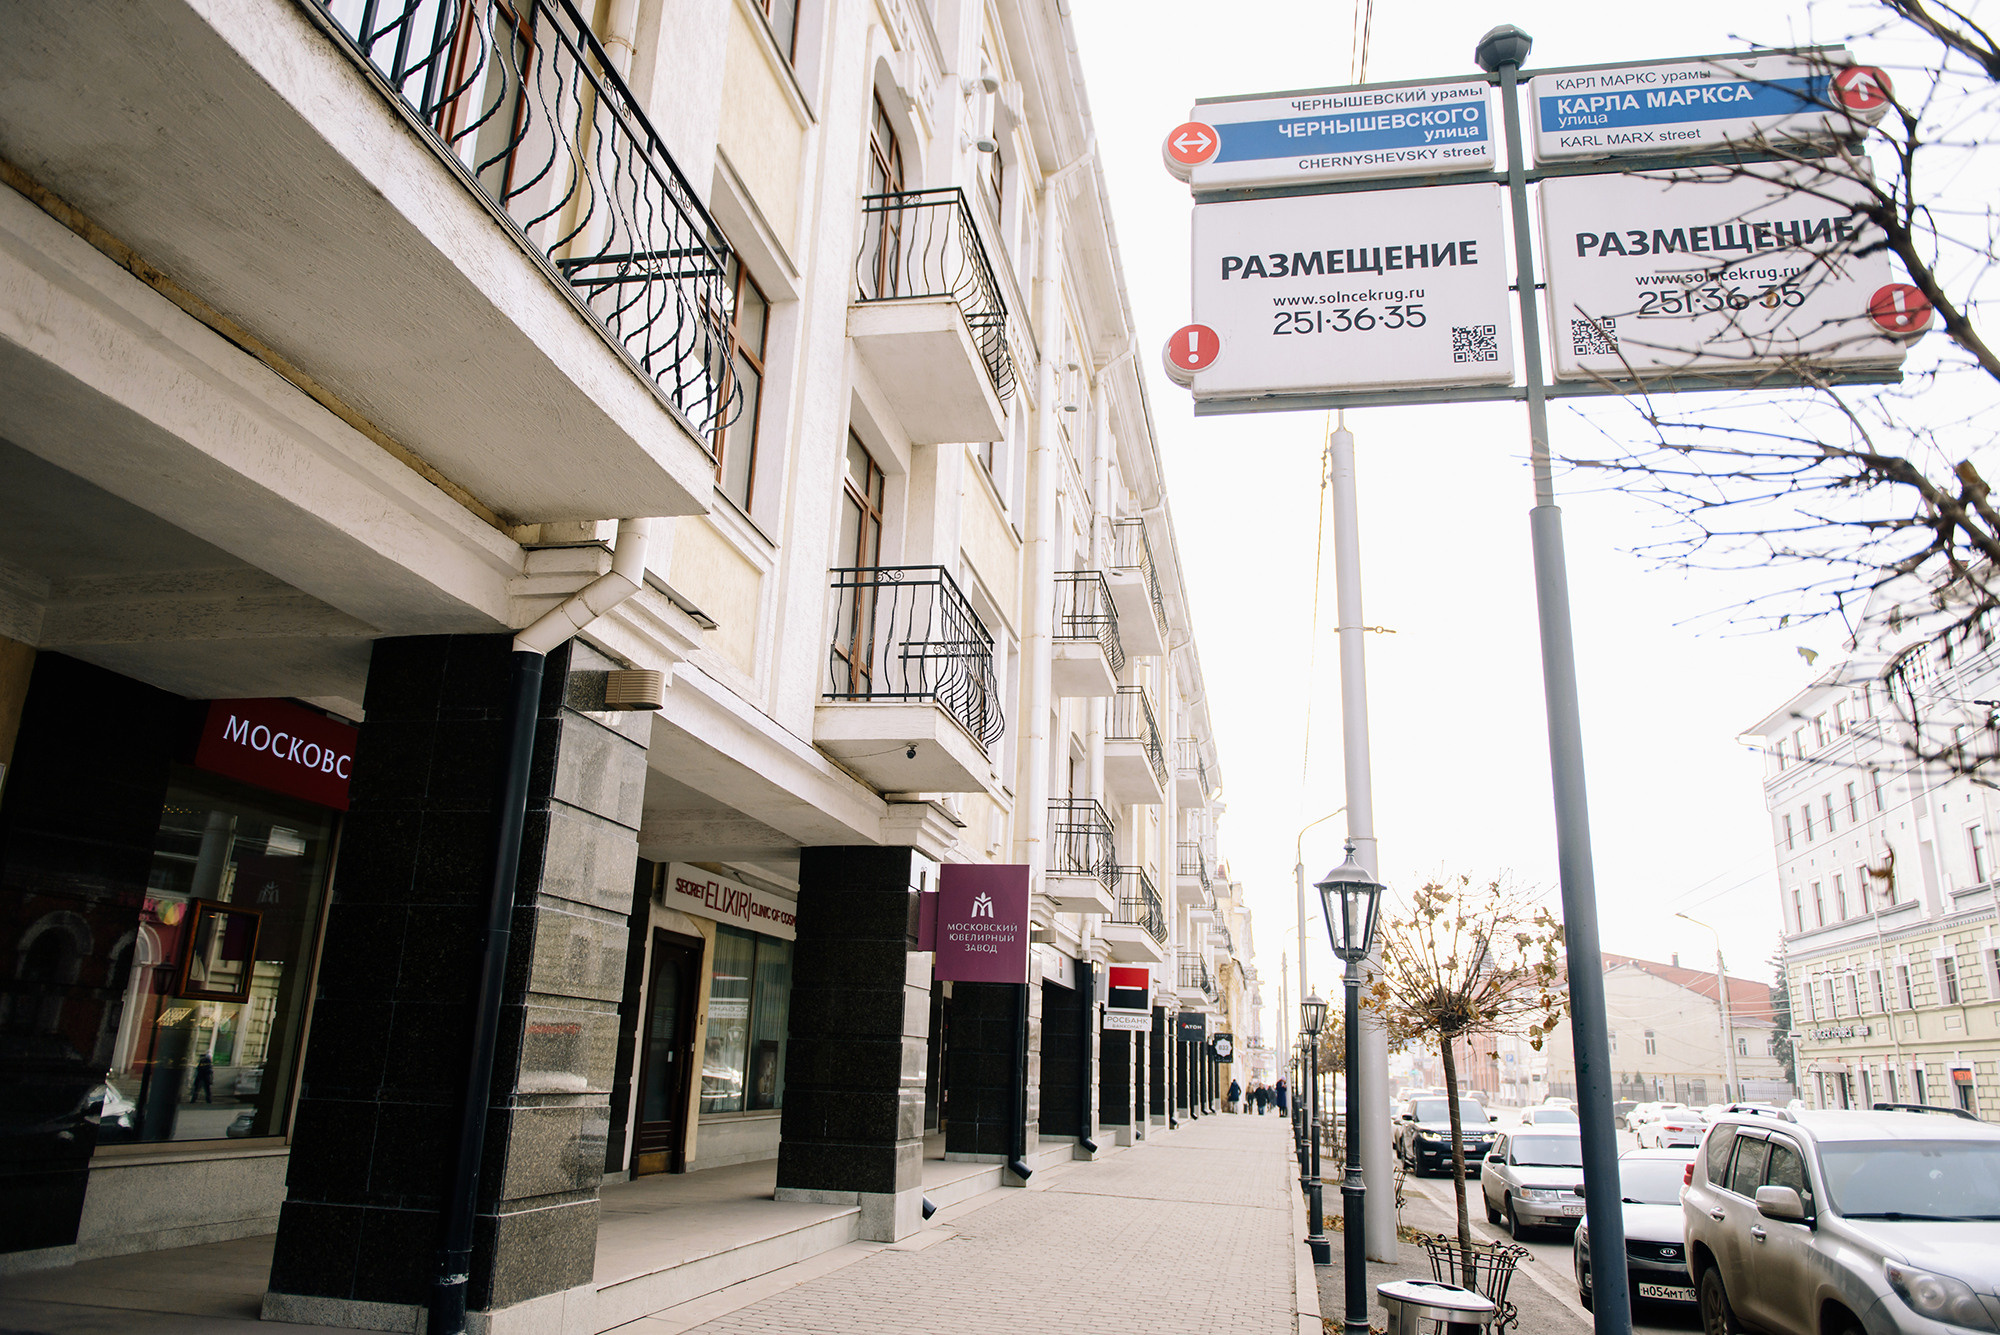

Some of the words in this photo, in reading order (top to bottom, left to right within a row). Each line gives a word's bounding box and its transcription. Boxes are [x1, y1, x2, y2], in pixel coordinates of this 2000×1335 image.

[1556, 76, 1596, 90] КАРЛ
[1601, 72, 1657, 87] МАРКС
[1661, 69, 1711, 84] урамы
[1291, 89, 1426, 111] ЧЕРНЫШЕВСКИЙ
[1431, 87, 1483, 102] урамы
[1557, 93, 1640, 115] КАРЛА
[1646, 84, 1754, 108] МАРКСА
[1278, 107, 1479, 138] ЧЕРНЫШЕВСКОГО
[1558, 113, 1608, 128] улица
[1424, 125, 1479, 143] улица
[1560, 134, 1602, 148] KARL
[1607, 131, 1655, 145] MARX
[1659, 128, 1702, 141] street
[1299, 149, 1438, 170] CHERNYSHEVSKY
[1443, 145, 1487, 158] street
[1575, 216, 1854, 257] РАЗМЕЩЕНИЕ
[1221, 240, 1478, 280] РАЗМЕЩЕНИЕ
[1273, 288, 1425, 307] www.solncekrug.ru
[675, 877, 706, 899] SECRET
[705, 880, 749, 919] ELIXIR
[751, 902, 772, 919] CLINIC
[771, 909, 781, 922] OF
[947, 922, 1018, 932] МОСКОВСКИЙ
[949, 933, 1015, 942] ЮВЕЛИРНЫЙ
[964, 943, 998, 954] ЗАВОД
[1106, 1016, 1148, 1024] РОСБАНК
[1641, 1286, 1684, 1299] Н054МТ
